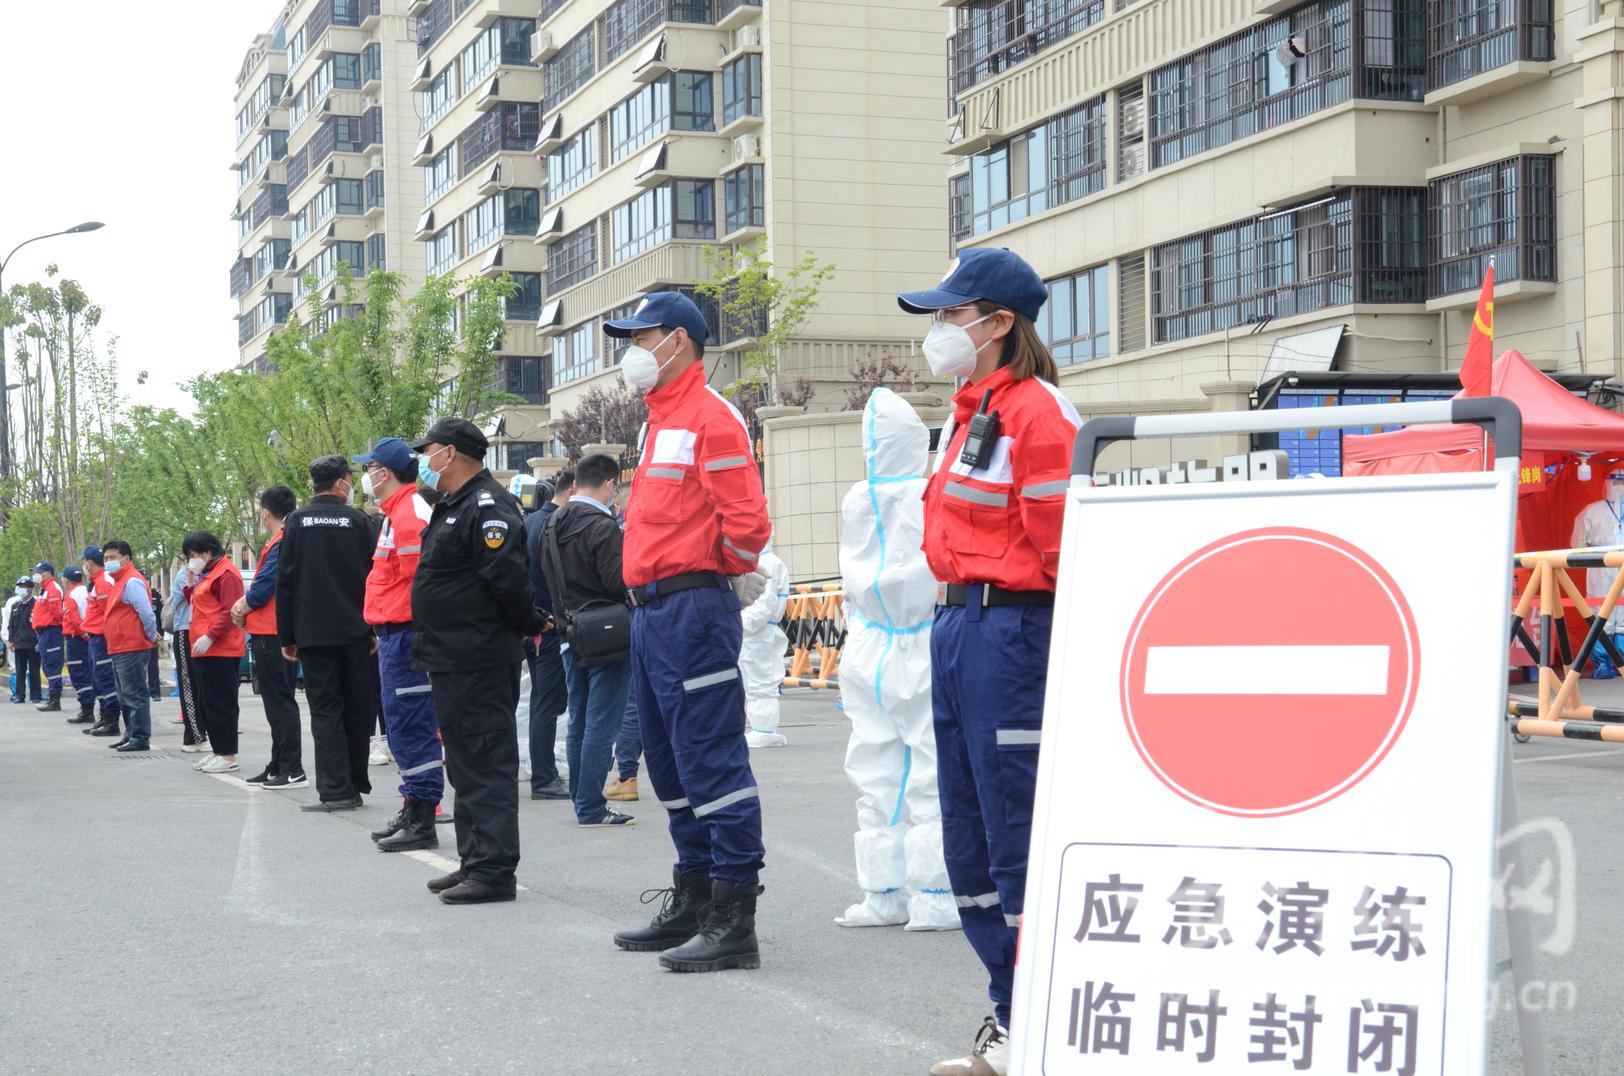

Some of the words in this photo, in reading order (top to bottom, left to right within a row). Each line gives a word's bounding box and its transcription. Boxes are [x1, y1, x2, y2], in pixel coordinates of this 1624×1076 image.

[1518, 465, 1541, 485] 锋岗
[1073, 873, 1427, 962] 应急演练
[1066, 979, 1421, 1076] 临时封闭
